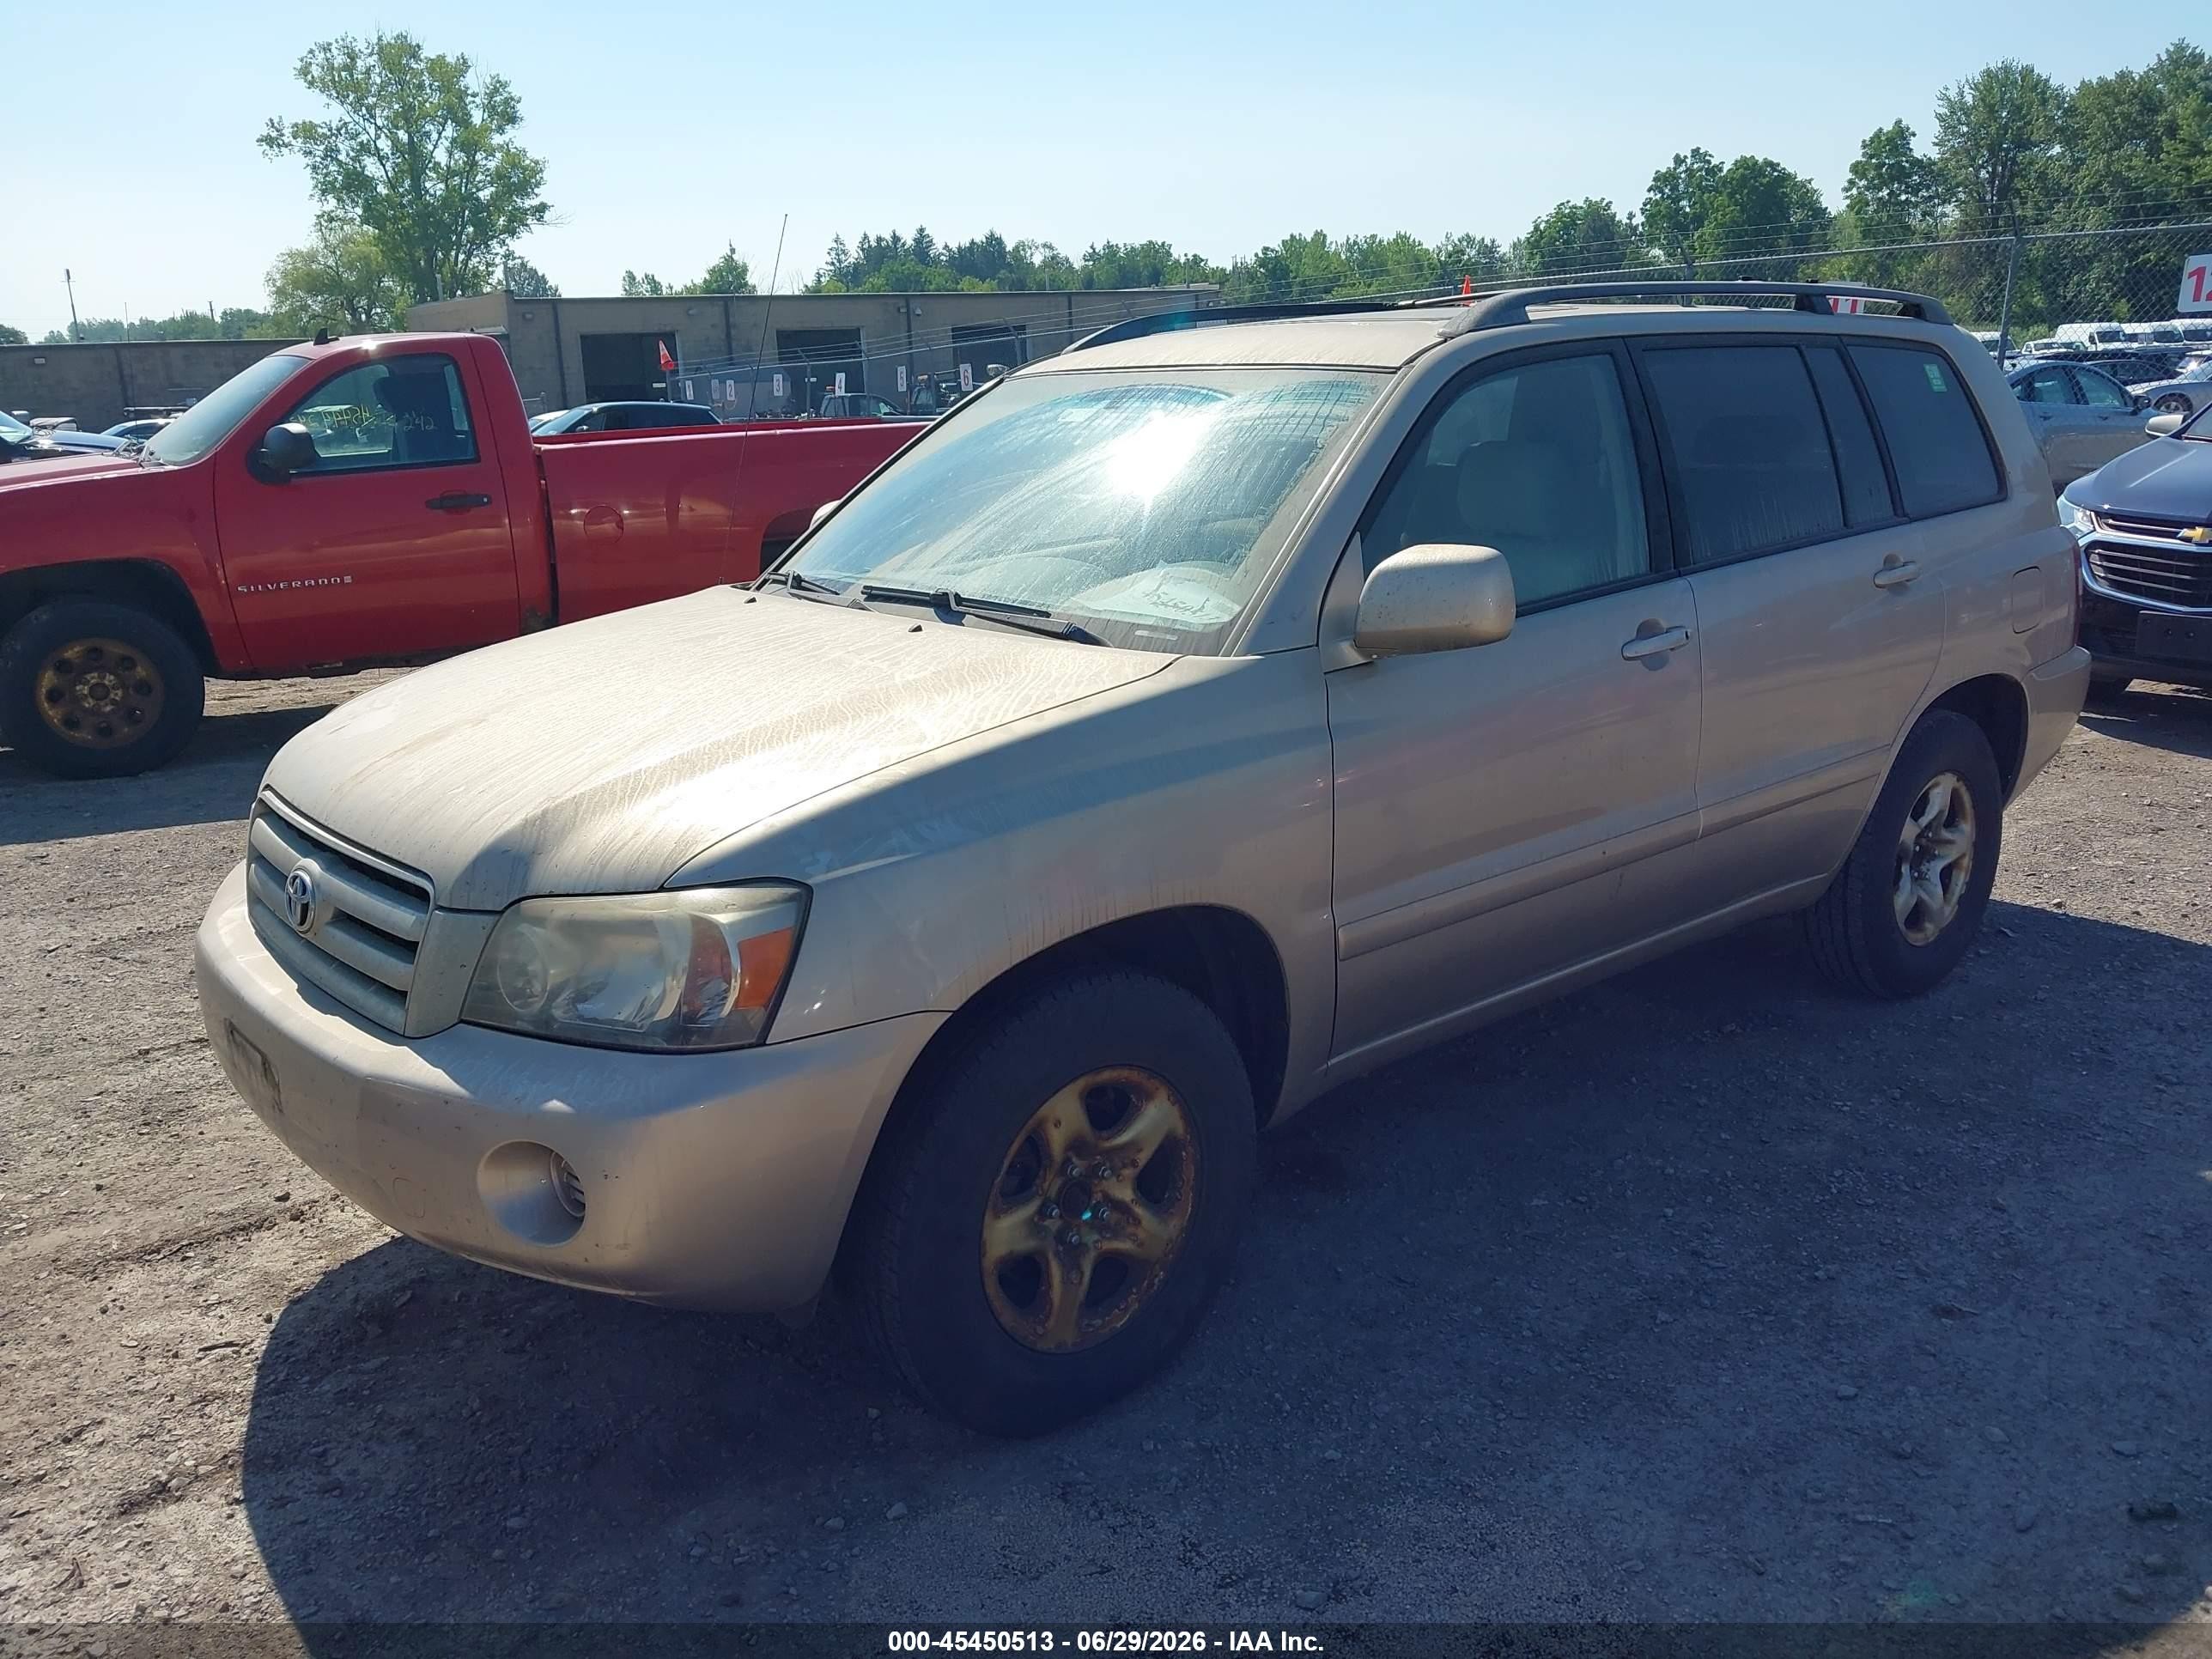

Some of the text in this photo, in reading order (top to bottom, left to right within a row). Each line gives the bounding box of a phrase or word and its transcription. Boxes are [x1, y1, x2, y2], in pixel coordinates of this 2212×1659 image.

[775, 378, 781, 392] 3
[963, 370, 969, 386] 6
[237, 576, 341, 592] SILVERADO
